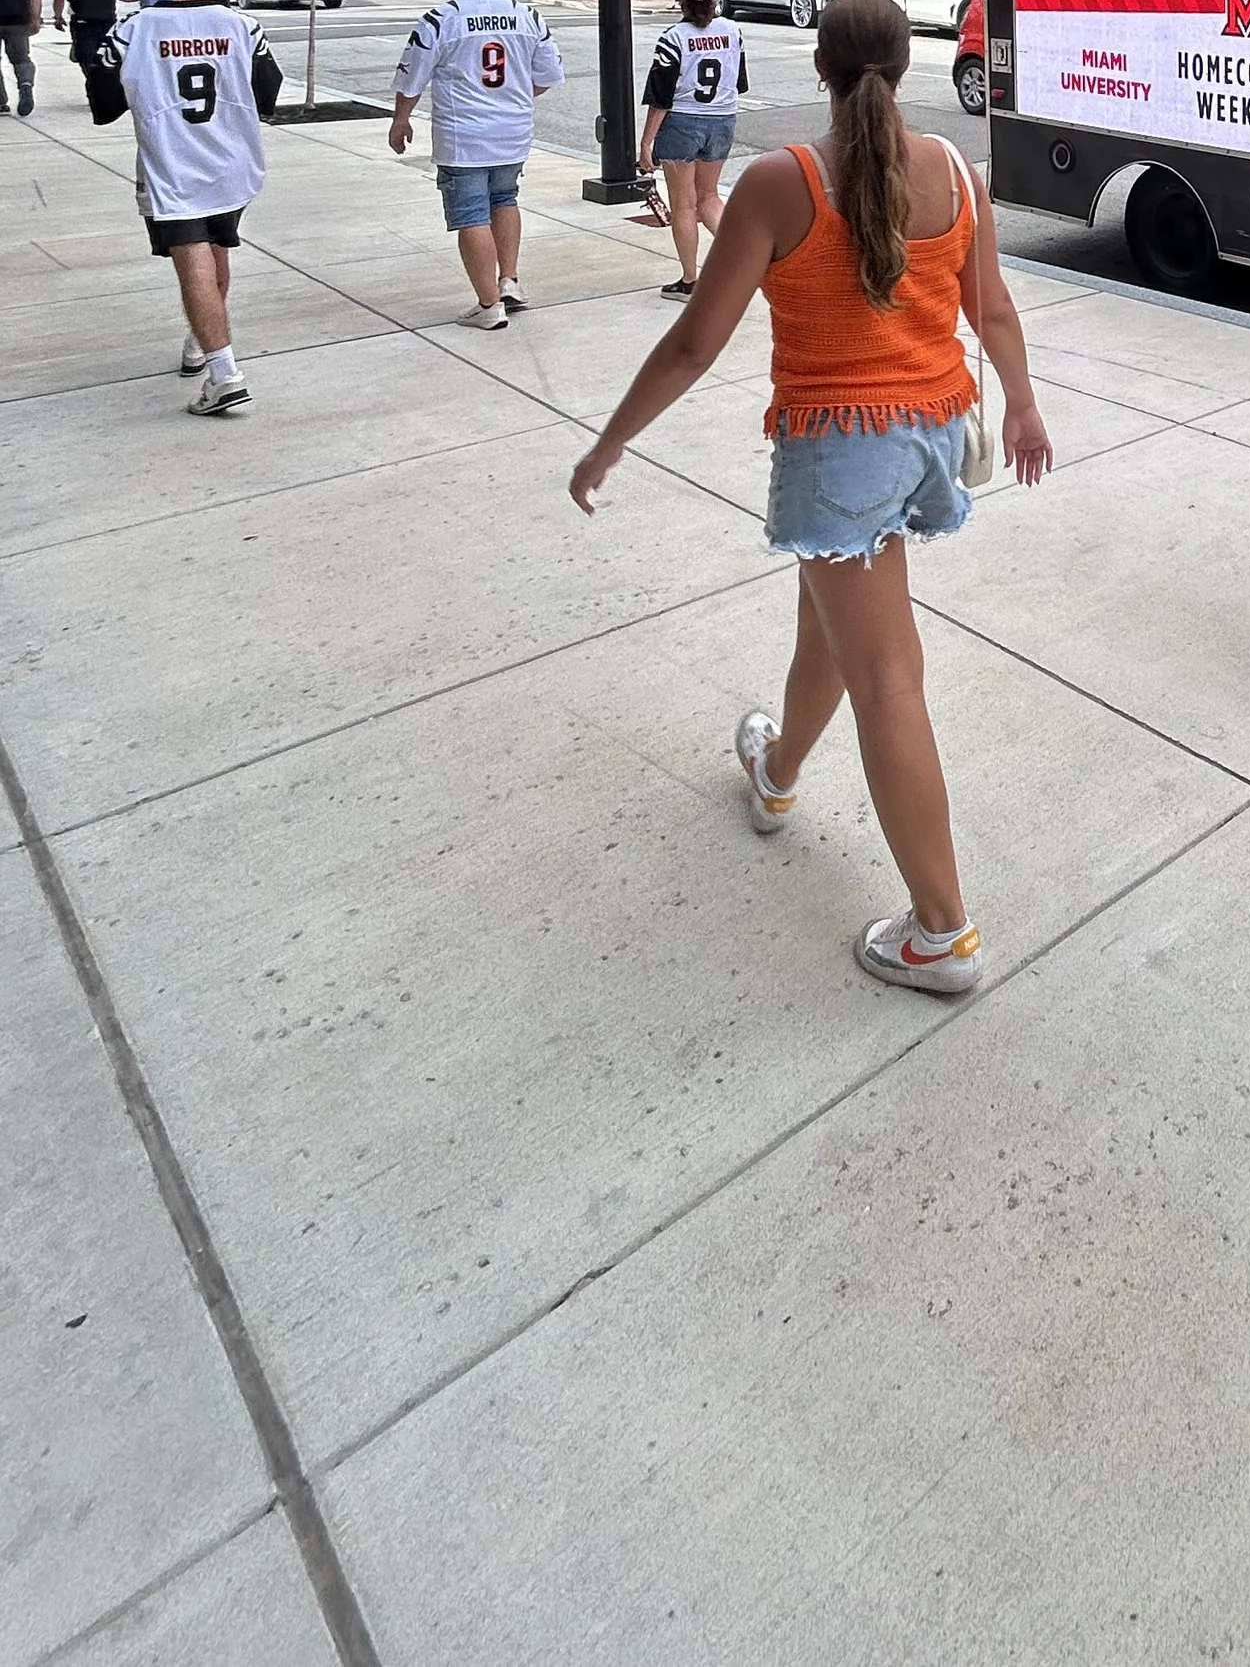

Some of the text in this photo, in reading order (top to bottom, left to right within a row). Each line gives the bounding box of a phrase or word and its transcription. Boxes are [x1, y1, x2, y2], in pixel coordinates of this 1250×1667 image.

[466, 16, 517, 32] BURROW
[159, 38, 230, 58] BURROW
[688, 35, 730, 52] BURROW
[481, 41, 506, 89] 9
[1082, 48, 1128, 73] MIAMI
[177, 63, 217, 124] 9
[694, 58, 722, 103] 9
[1060, 72, 1152, 102] UNIVERSITY
